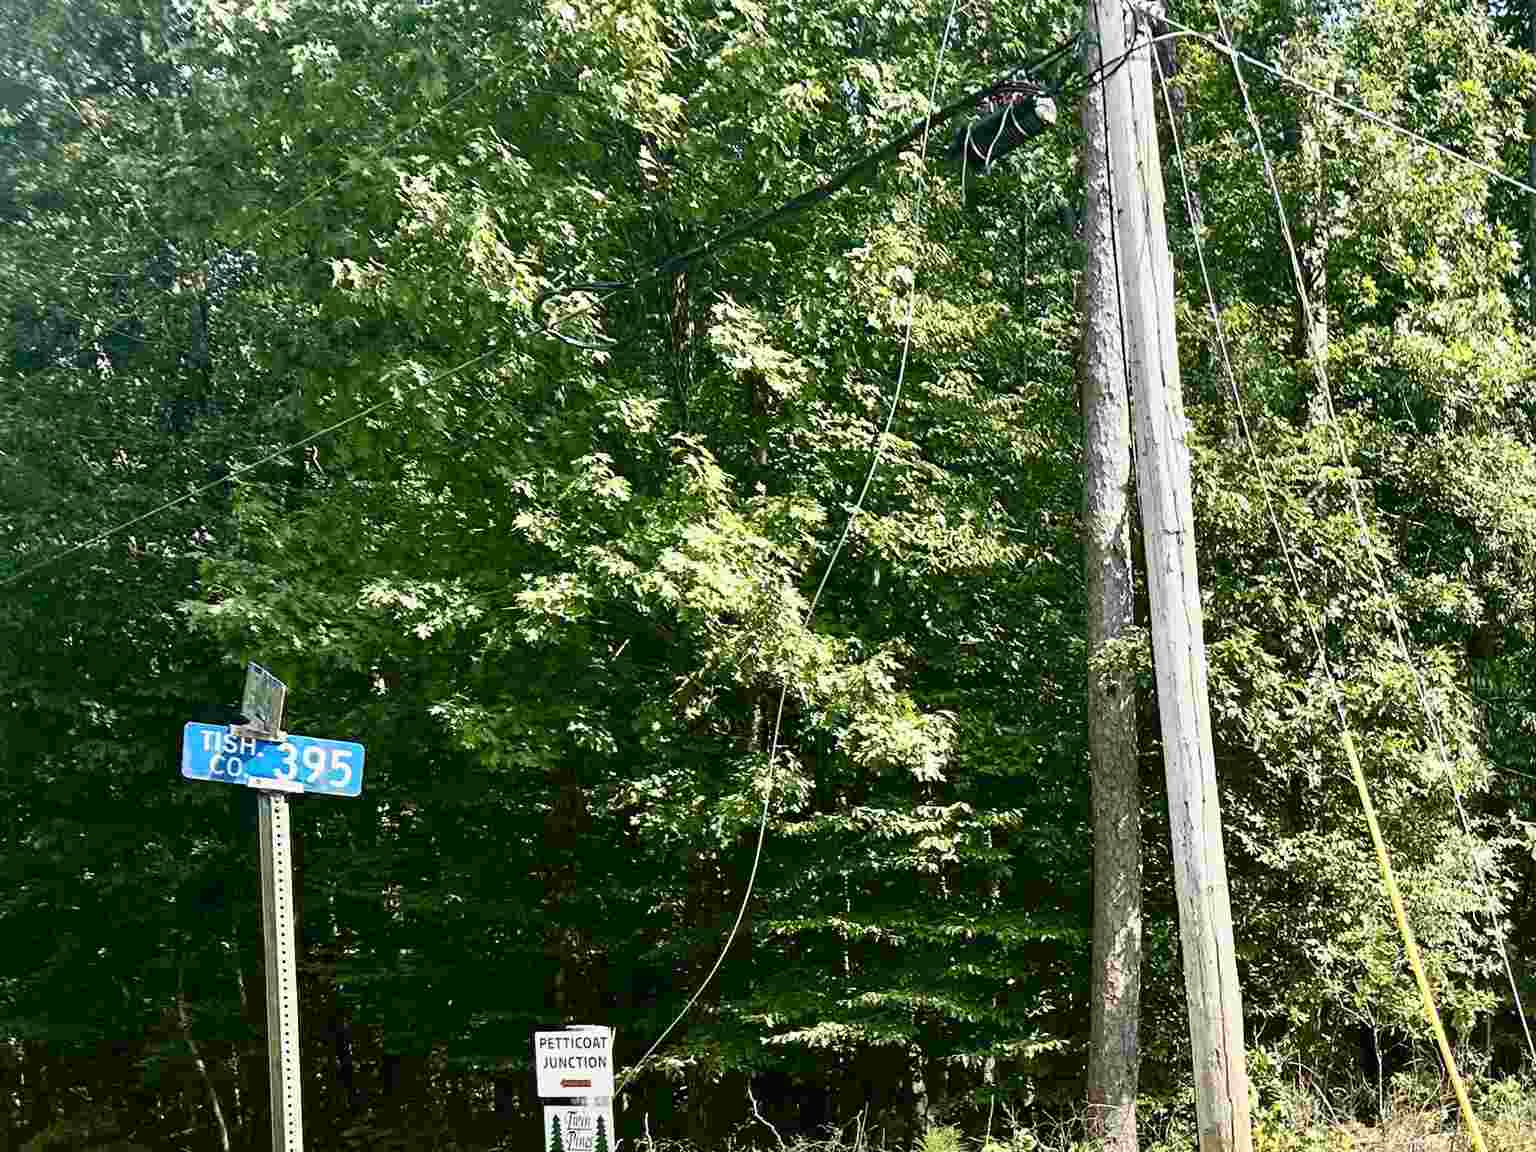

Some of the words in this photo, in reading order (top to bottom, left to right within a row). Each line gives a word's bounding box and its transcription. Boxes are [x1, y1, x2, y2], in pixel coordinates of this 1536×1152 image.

[275, 742, 353, 787] 395
[539, 1036, 608, 1049] PETTICOAT
[543, 1056, 607, 1069] JUNCTION
